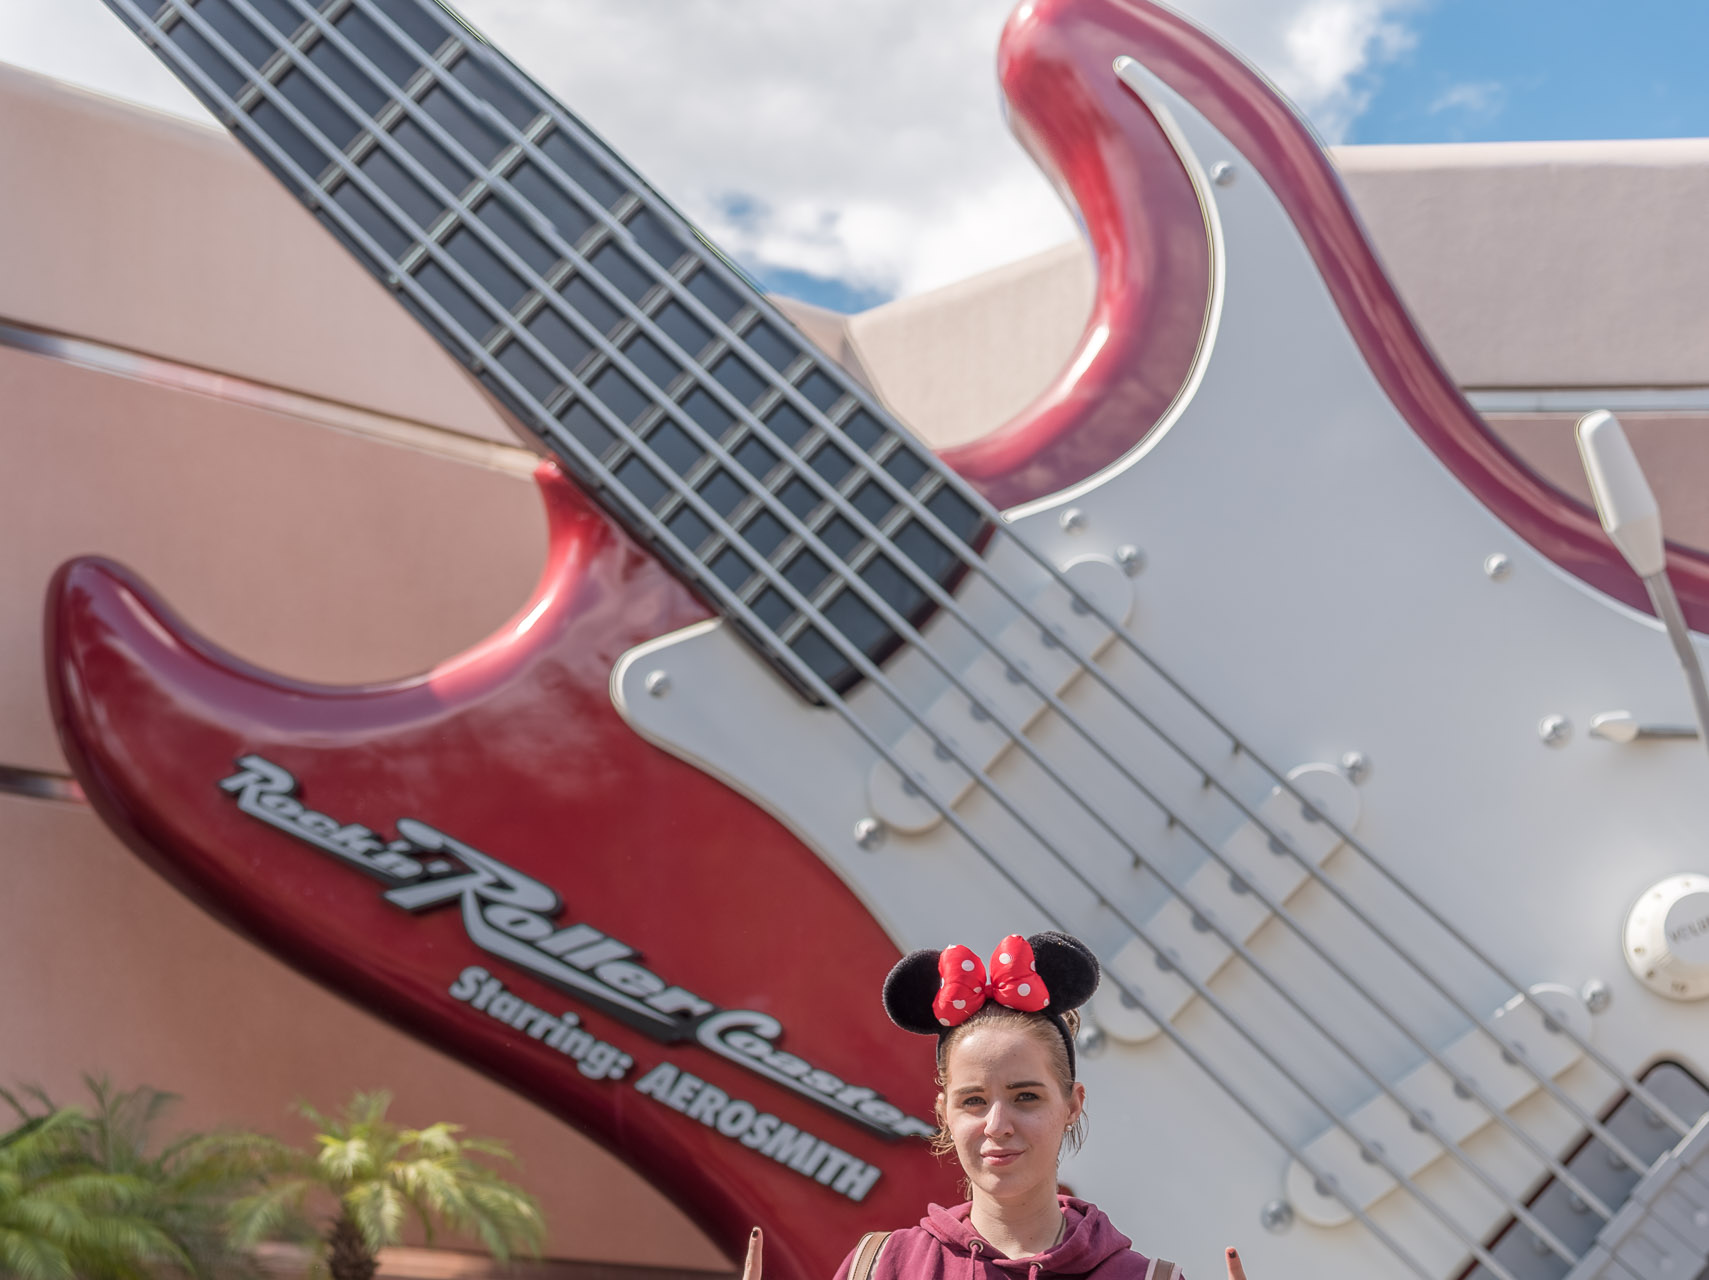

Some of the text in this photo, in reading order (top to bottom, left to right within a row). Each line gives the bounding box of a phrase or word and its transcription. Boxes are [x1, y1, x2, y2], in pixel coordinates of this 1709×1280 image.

[219, 754, 939, 1138] Rockin' Roller Coaster
[449, 965, 882, 1202] Starring: AEROSMITH
